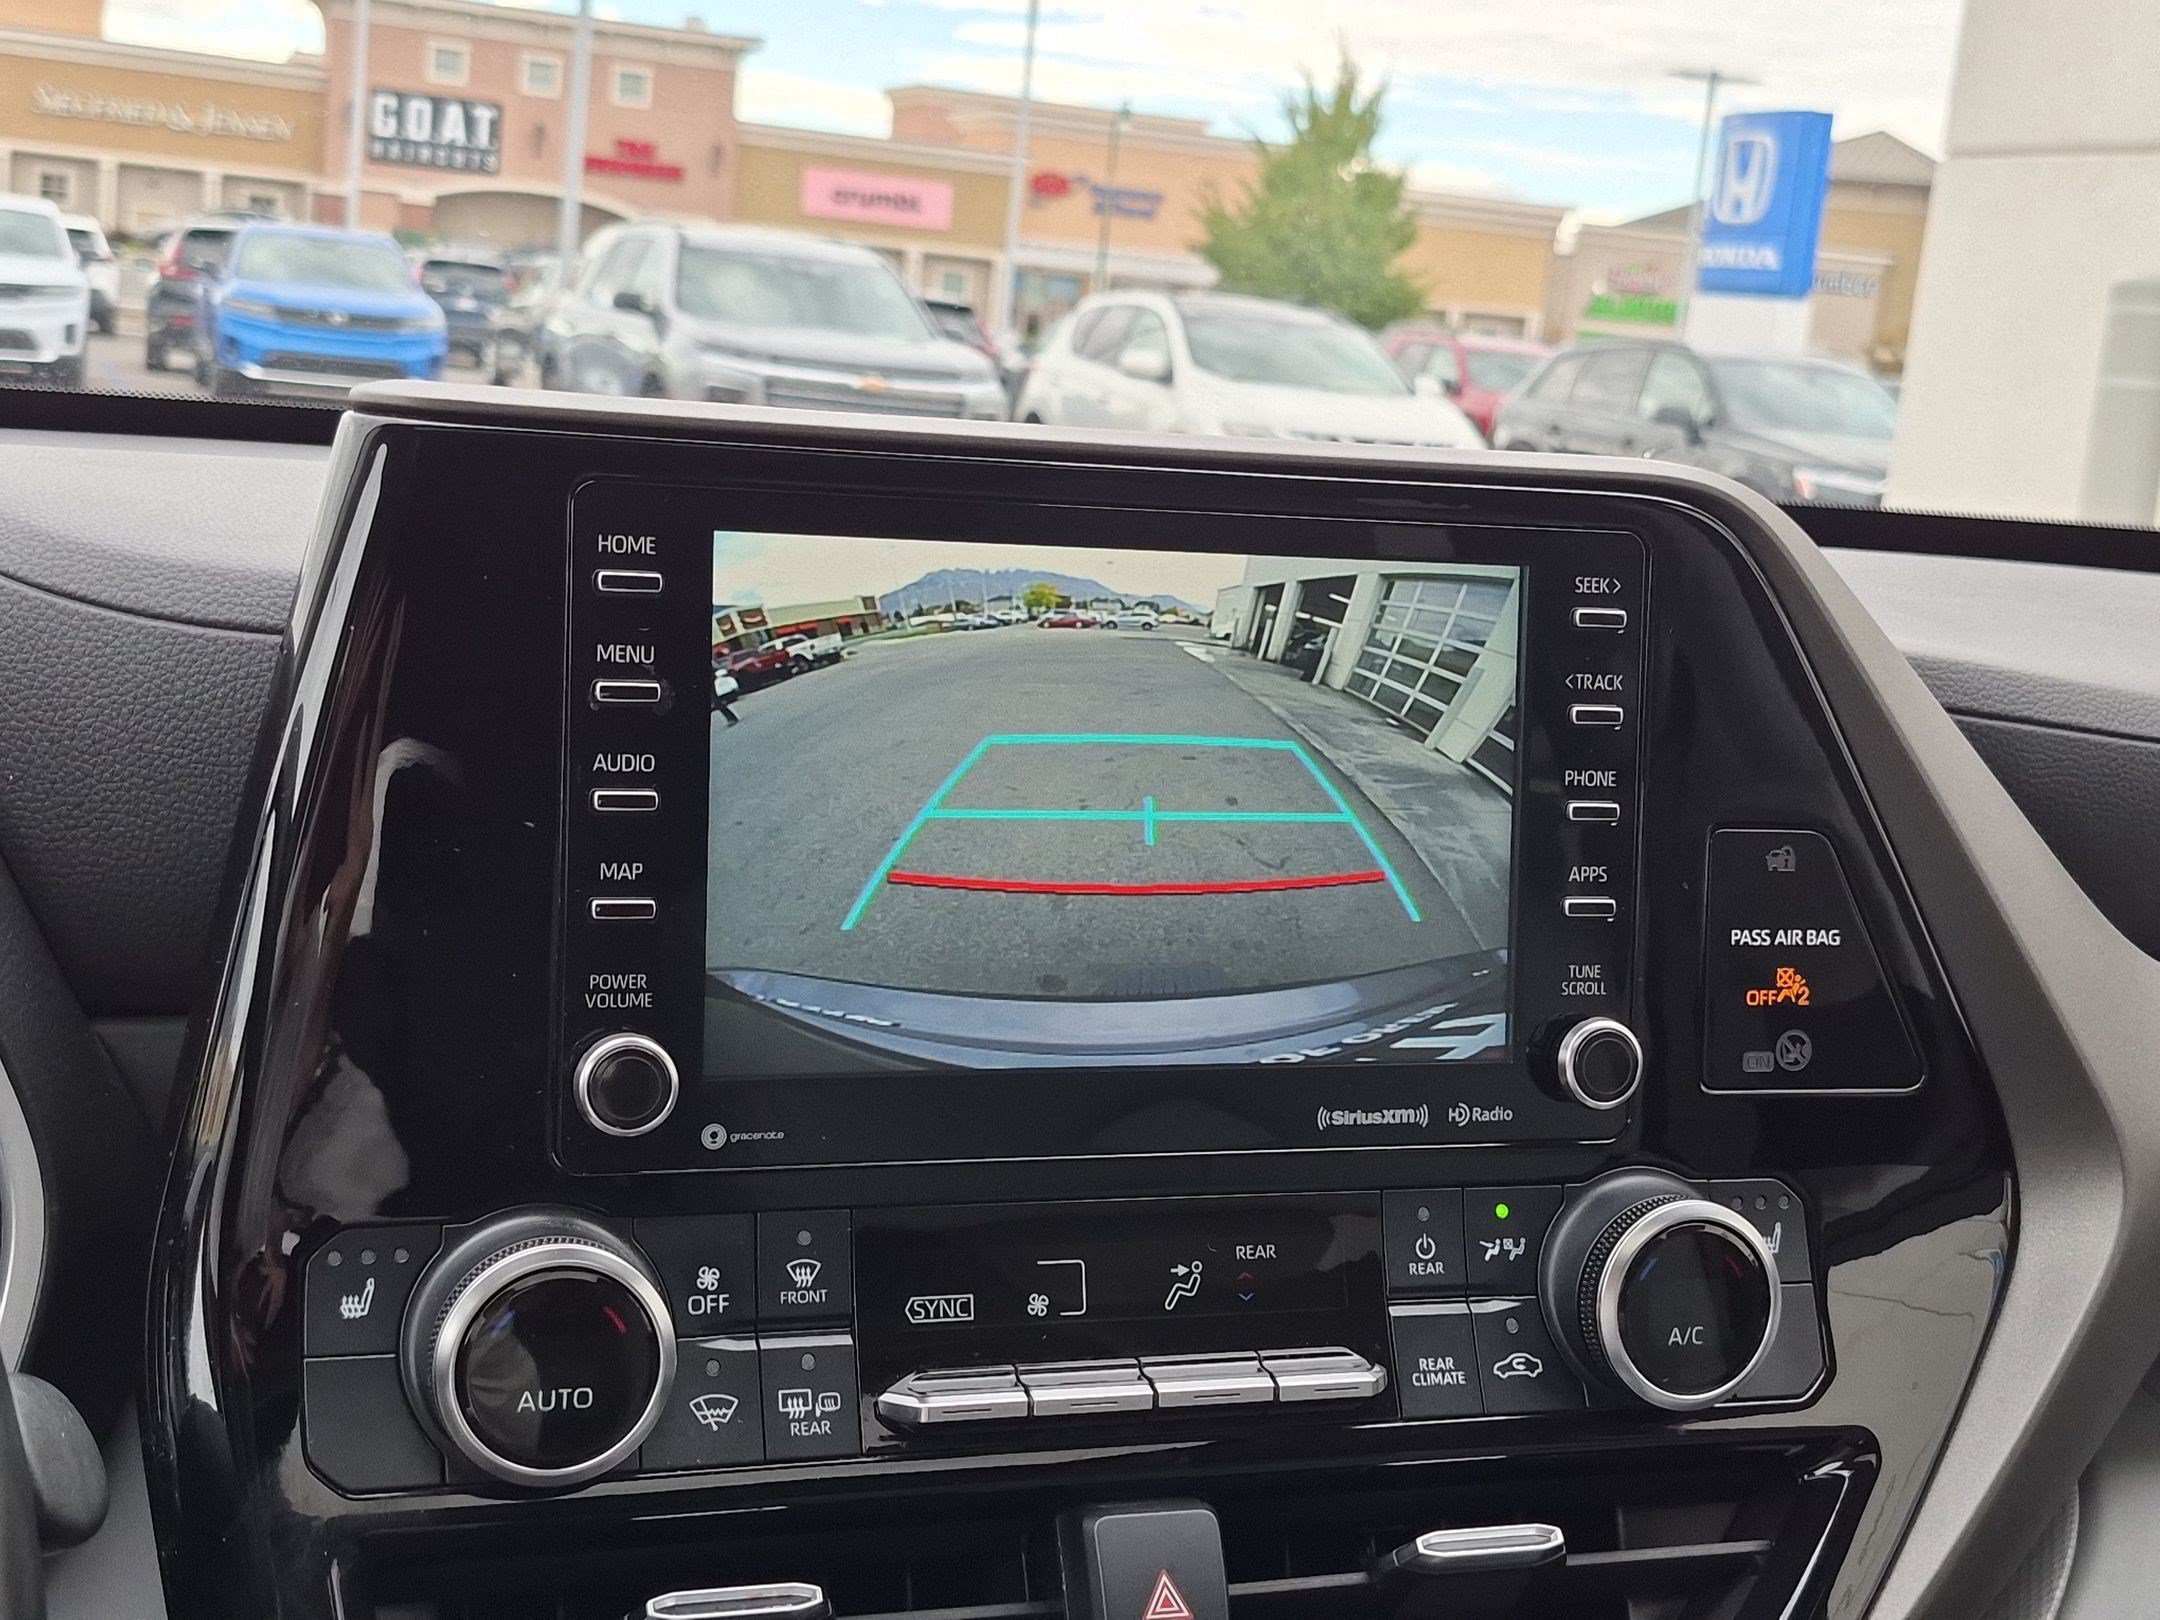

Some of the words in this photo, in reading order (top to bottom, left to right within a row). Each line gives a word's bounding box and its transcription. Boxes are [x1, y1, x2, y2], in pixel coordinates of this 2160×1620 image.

[599, 535, 656, 554] HOME
[597, 644, 654, 663] MENU
[593, 754, 655, 771] AUDIO
[1565, 770, 1616, 786] PHONE
[601, 863, 642, 880] MAP
[1569, 867, 1607, 882] APPS
[1732, 930, 1771, 945] PASS
[1774, 930, 1803, 945] AIR
[1807, 930, 1840, 945] BAG
[1569, 965, 1600, 978] TUNE
[590, 974, 646, 989] POWER
[1562, 982, 1606, 995] SCROLL
[585, 993, 652, 1008] VOLUME
[1747, 990, 1777, 1005] OFF
[1472, 1105, 1513, 1122] Radio
[730, 1132, 784, 1142] gracenote
[1236, 1245, 1276, 1259] REAR
[1409, 1262, 1444, 1275] REAR
[688, 1294, 729, 1314] OFF
[781, 1289, 827, 1304] FRONT
[914, 1299, 967, 1319] SYNC
[1668, 1327, 1703, 1345] A/C
[1419, 1357, 1455, 1371] REAR
[1413, 1370, 1466, 1386] CLIMATE
[517, 1388, 592, 1412] AUTO
[789, 1421, 831, 1436] REAR
